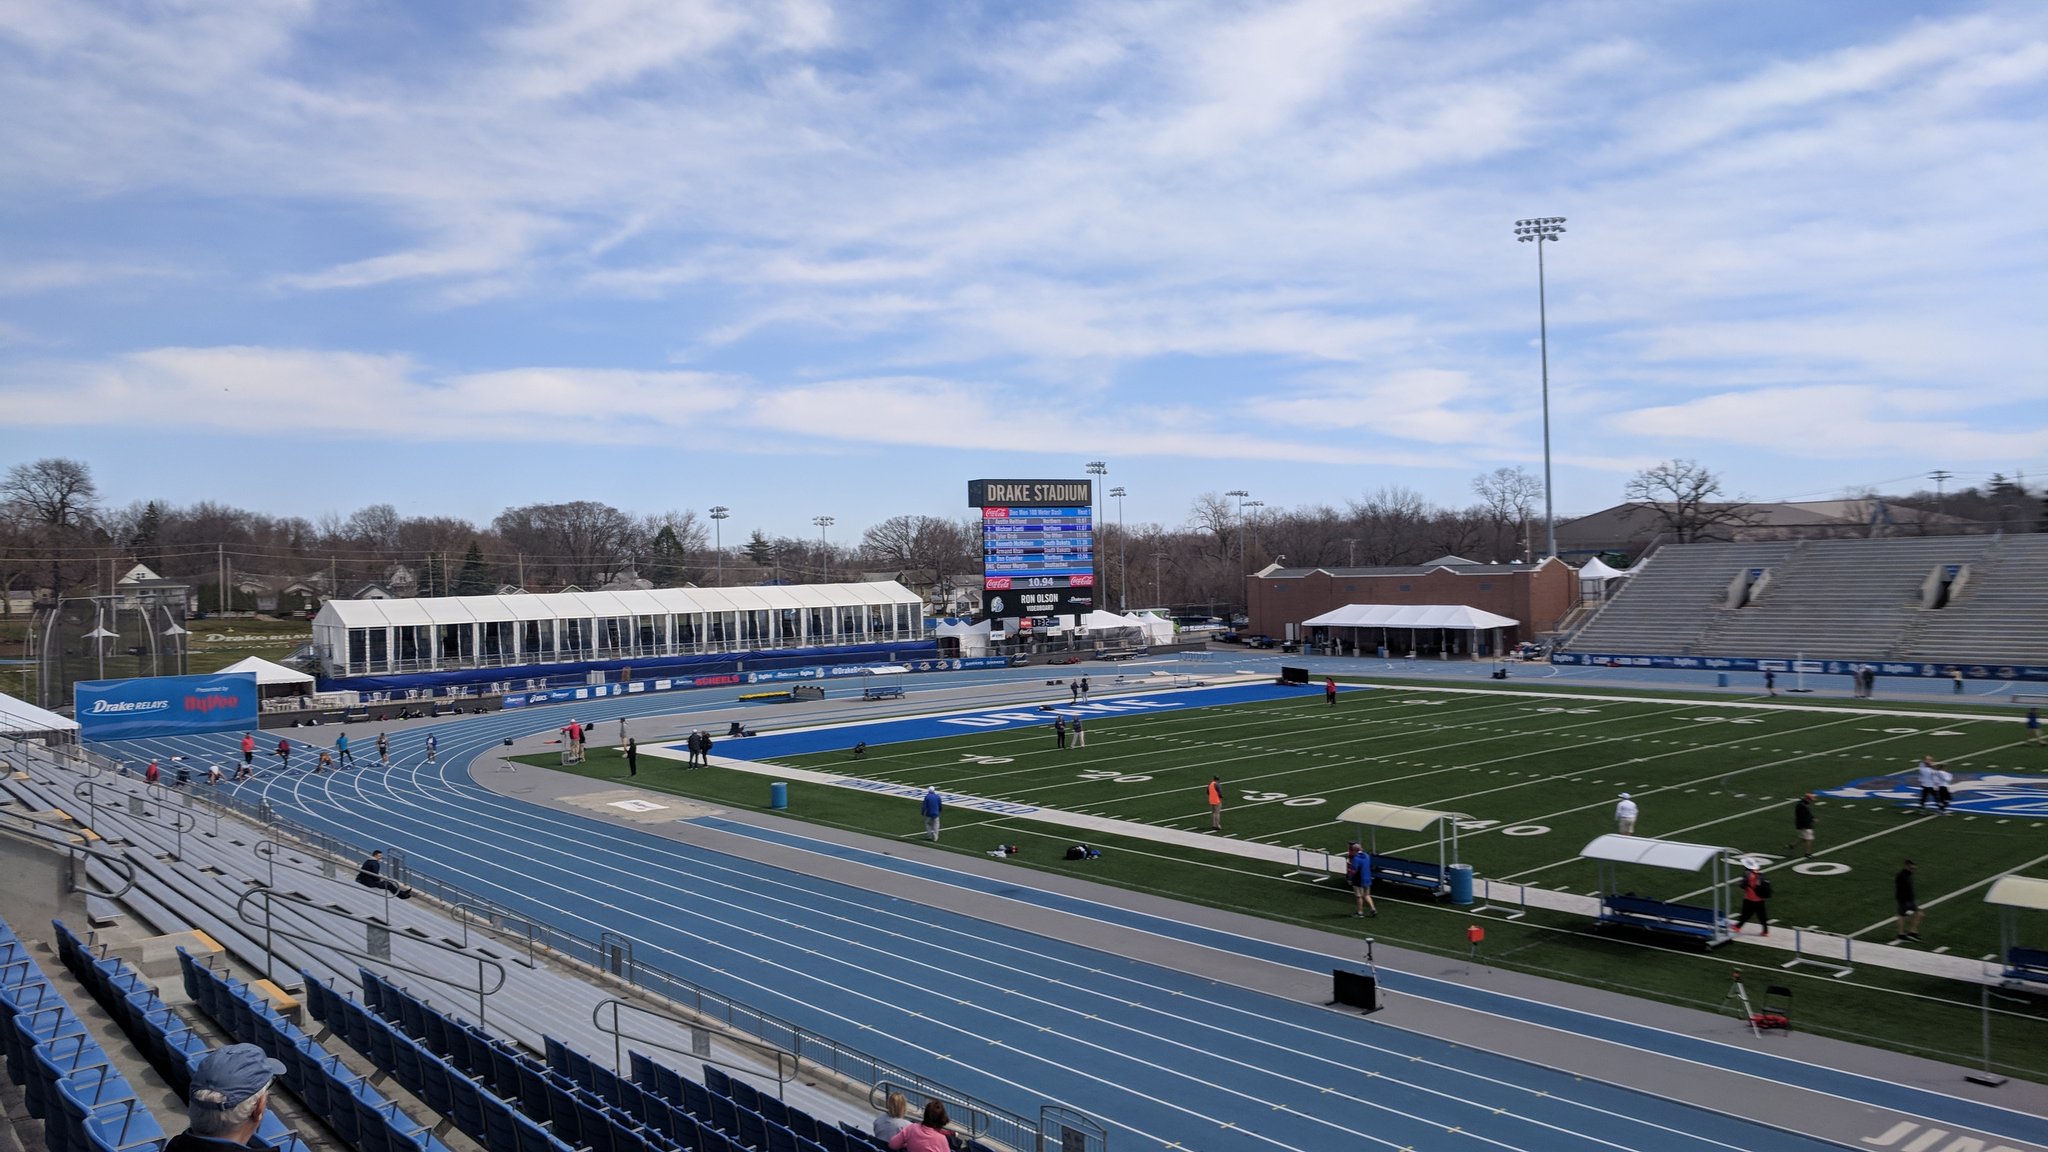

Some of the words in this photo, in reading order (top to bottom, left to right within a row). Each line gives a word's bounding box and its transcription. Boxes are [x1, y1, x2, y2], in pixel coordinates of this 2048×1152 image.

[987, 484, 1031, 502] DRAKE
[1034, 483, 1088, 501] STADIUM
[1028, 577, 1054, 587] 10.94
[1020, 594, 1035, 604] RON
[1036, 593, 1059, 603] OLSON
[1026, 604, 1054, 612] VIDEOBOARD
[205, 633, 268, 642] Drake
[695, 675, 740, 686] SCHEELS
[92, 699, 136, 713] Drake
[135, 700, 169, 710] RELAYS
[937, 699, 1185, 727] DRAKE
[1242, 792, 1327, 807] 30
[1450, 820, 1552, 836] 40
